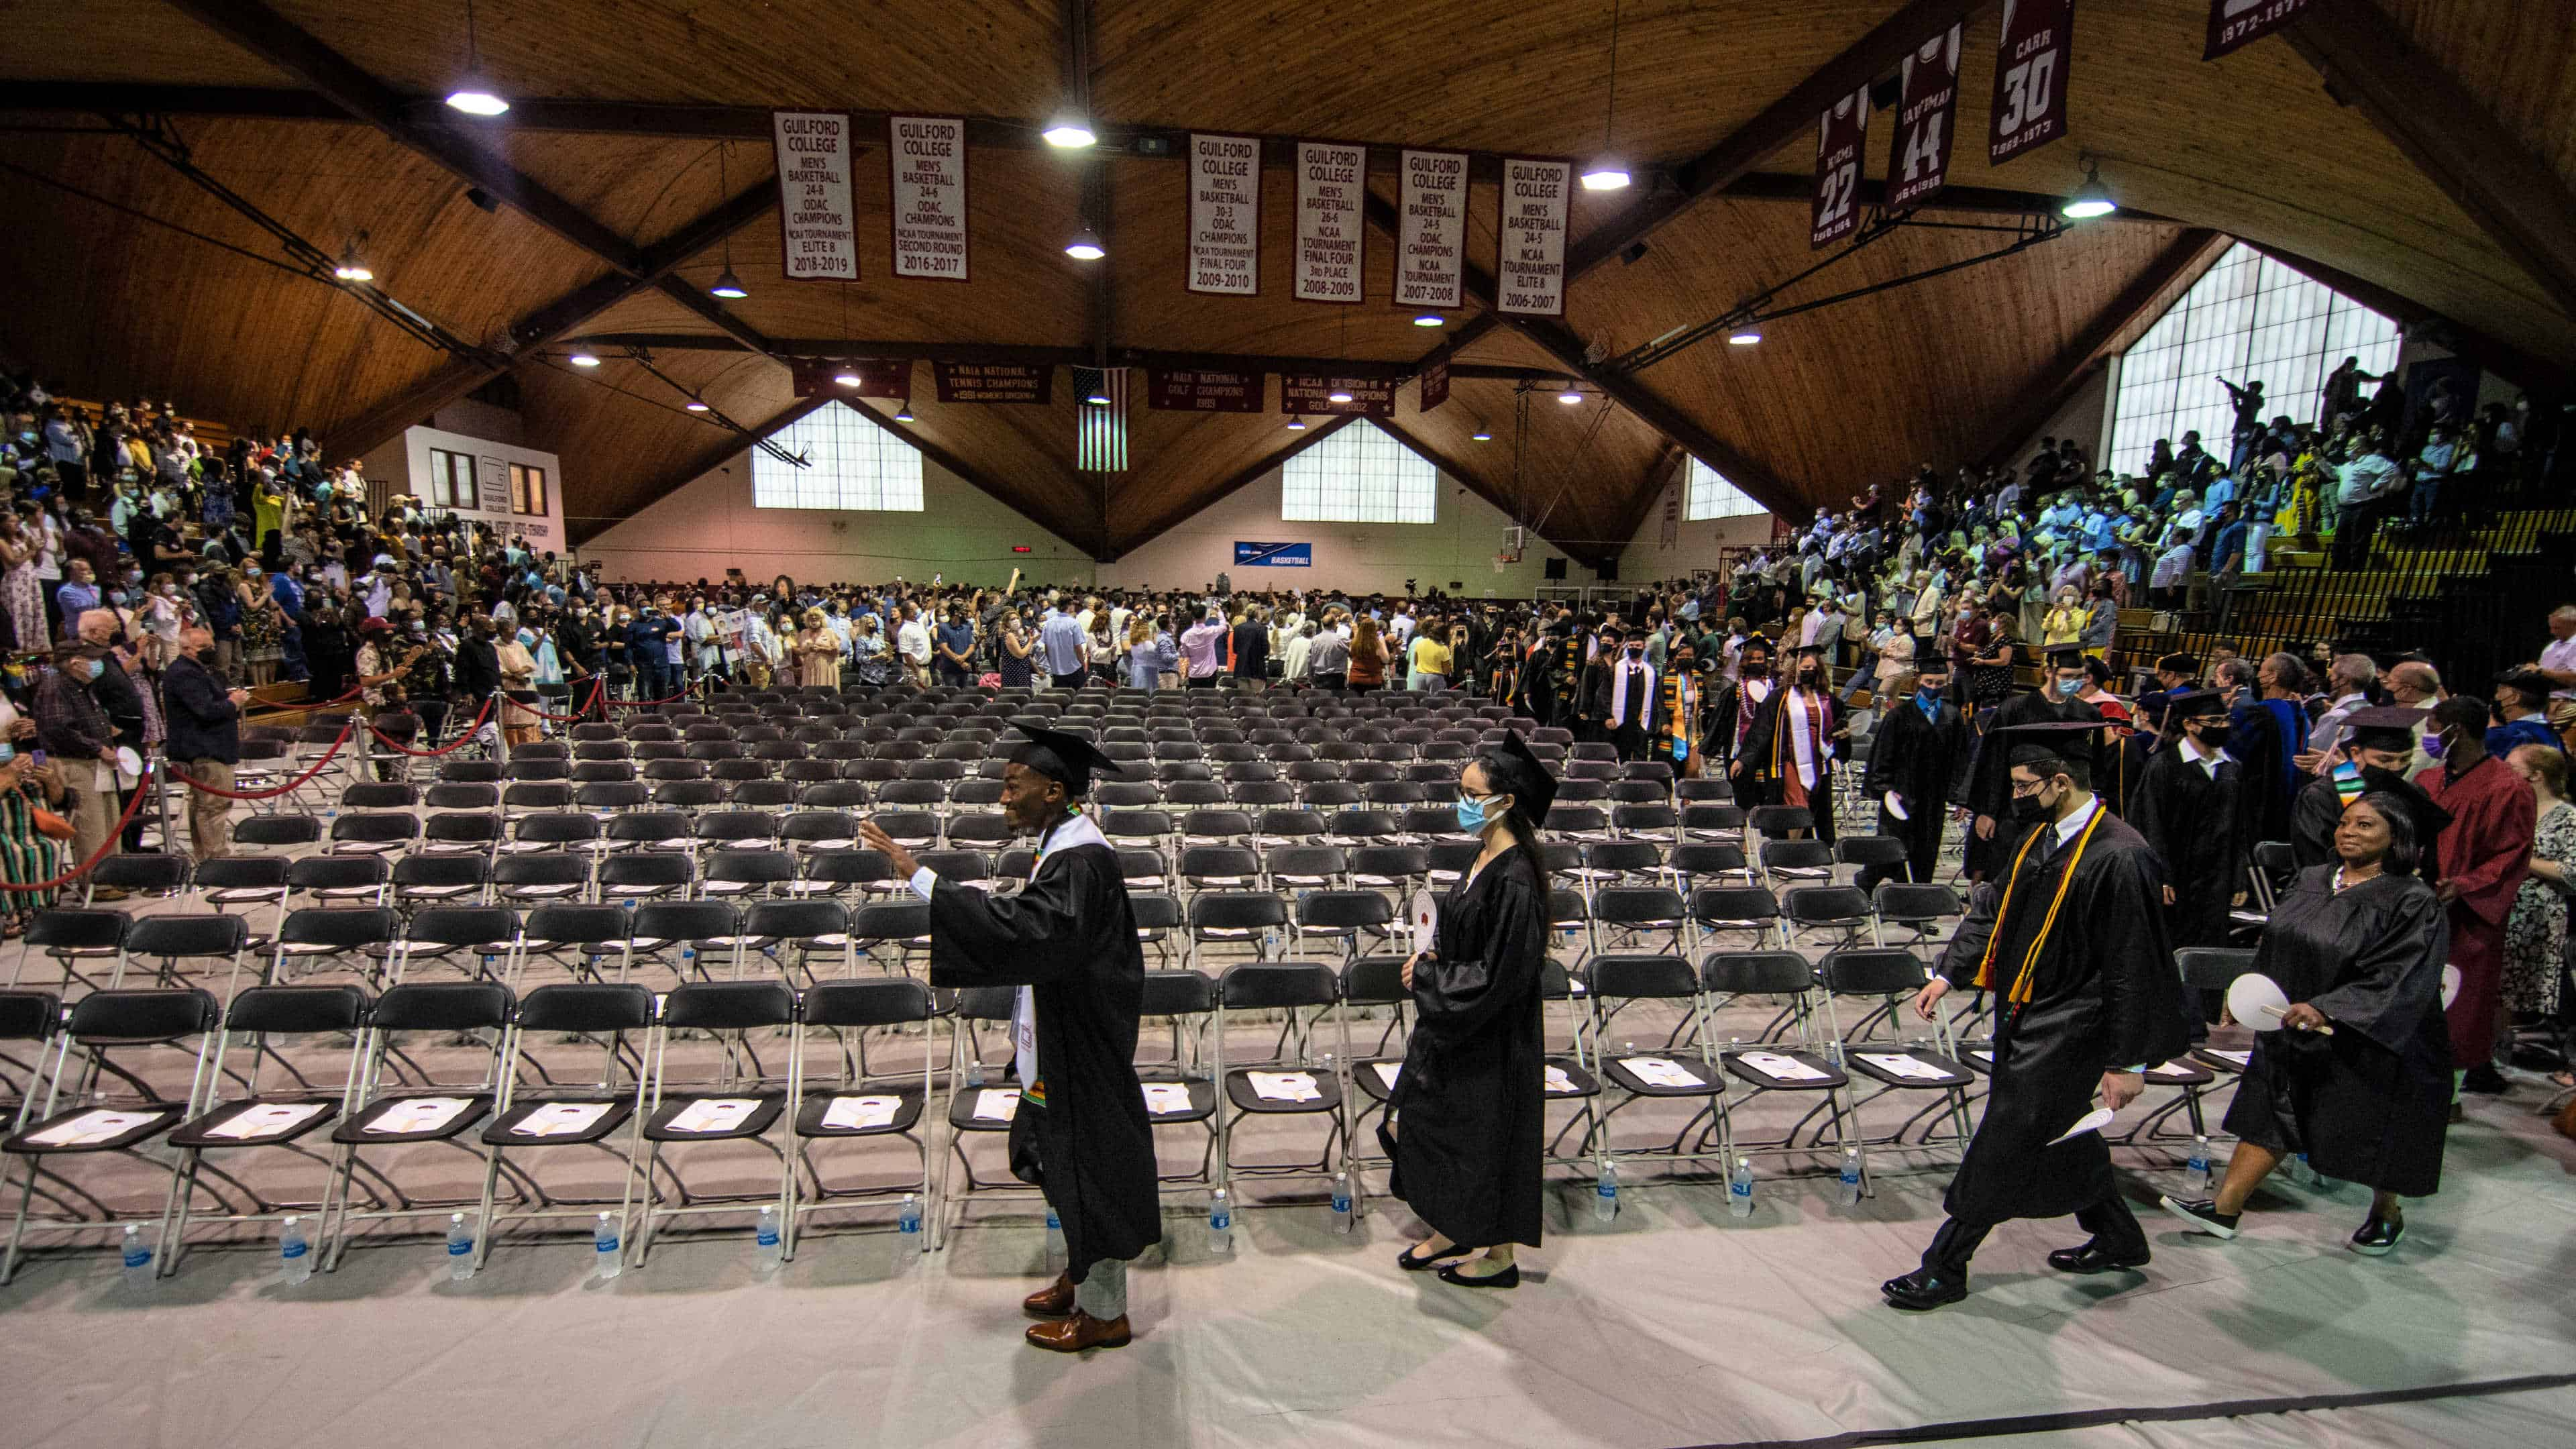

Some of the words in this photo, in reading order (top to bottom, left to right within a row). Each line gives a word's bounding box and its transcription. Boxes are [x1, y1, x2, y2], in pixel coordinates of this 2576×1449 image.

[2016, 29, 2051, 59] CARR
[1999, 48, 2057, 136] 30
[784, 119, 839, 135] GUILFORD
[900, 124, 955, 140] GUILFORD
[789, 138, 837, 153] COLLEGE
[904, 141, 951, 156] COLLEGE
[1199, 142, 1252, 158] GUILFORD
[1902, 111, 1943, 182] 44
[800, 157, 826, 169] MEN'S
[1306, 150, 1358, 166] GUILFORD
[916, 160, 941, 171] MEN'S
[1203, 160, 1248, 176] COLLEGE
[1410, 157, 1460, 173] GUILFORD
[789, 171, 841, 183] BASKETBALL
[903, 172, 955, 186] BASKETBALL
[1309, 166, 1353, 182] COLLEGE
[1512, 166, 1562, 182] GUILFORD
[1213, 178, 1236, 189] MEN'S
[1413, 174, 1456, 190] COLLEGE
[806, 185, 823, 195] 24-8
[920, 187, 937, 197] 24-6
[1319, 186, 1342, 198] MEN'S
[1515, 183, 1558, 198] COLLEGE
[1818, 162, 1856, 229] 22
[1200, 191, 1249, 204] BASKETBALL
[1422, 193, 1444, 205] MEN'S
[804, 200, 828, 211] ODAC
[918, 201, 941, 212] ODAC
[1307, 199, 1354, 211] BASKETBALL
[1523, 204, 1548, 216] MEN'S
[1216, 207, 1232, 217] 30-3
[1409, 205, 1455, 218] BASKETBALL
[794, 213, 843, 225] CHAMPIONS
[906, 213, 955, 226] CHAMPIONS
[1322, 213, 1338, 223] 26-6
[1424, 219, 1439, 229] 24-5
[1509, 217, 1560, 230] BASKETBALL
[1213, 219, 1234, 230] ODAC
[789, 229, 802, 239] NCAA
[804, 229, 852, 240] TOURNAMENT
[898, 229, 916, 238] NCAA
[917, 230, 962, 241] TOURNAMENT
[1200, 231, 1247, 244] CHAMPIONS
[1319, 226, 1340, 237] NCAA
[1303, 237, 1356, 251] TOURNAMENT
[1420, 233, 1442, 244] ODAC
[1525, 233, 1542, 244] 24-5
[803, 242, 826, 252] ELITE
[829, 242, 835, 252] 8
[899, 240, 931, 252] SECOND
[934, 243, 963, 255] ROUND
[1193, 246, 1209, 254] NCAA
[1212, 248, 1253, 258] TOURNAMENT
[1408, 244, 1453, 257] CHAMPIONS
[1305, 252, 1328, 263] FINAL
[1331, 253, 1353, 264] FOUR
[1521, 250, 1544, 260] NCAA
[795, 258, 847, 271] 2018-2019
[906, 257, 958, 272] 2016-2017
[1200, 258, 1223, 269] FINAL
[1225, 260, 1246, 270] FOUR
[1419, 260, 1440, 271] NCAA
[1504, 261, 1560, 275] TOURNAMENT
[1325, 268, 1348, 278] PLACE
[1405, 271, 1454, 284] TOURNAMENT
[1197, 272, 1248, 288] 2009-2010
[1517, 276, 1538, 288] ELITE
[1540, 279, 1545, 288] 8
[1303, 280, 1354, 295] 2008-2009
[1405, 286, 1453, 301] 2007-2008
[1506, 294, 1554, 308] 2006-2007
[959, 365, 981, 376] NAIA
[984, 366, 1026, 376] NATIONAL
[950, 378, 982, 387] TENNIS
[987, 379, 1038, 388] CHAMPIONS
[1173, 372, 1192, 382] NAIA
[1200, 374, 1240, 384] NATIONAL
[1299, 378, 1323, 388] NCAA
[1370, 380, 1378, 389] III
[1169, 385, 1189, 395] GOLF
[1197, 386, 1244, 397] CHAMPIONS
[1288, 388, 1328, 398] NATIONAL
[1309, 401, 1331, 411] GOLF
[1346, 402, 1368, 412] 2002
